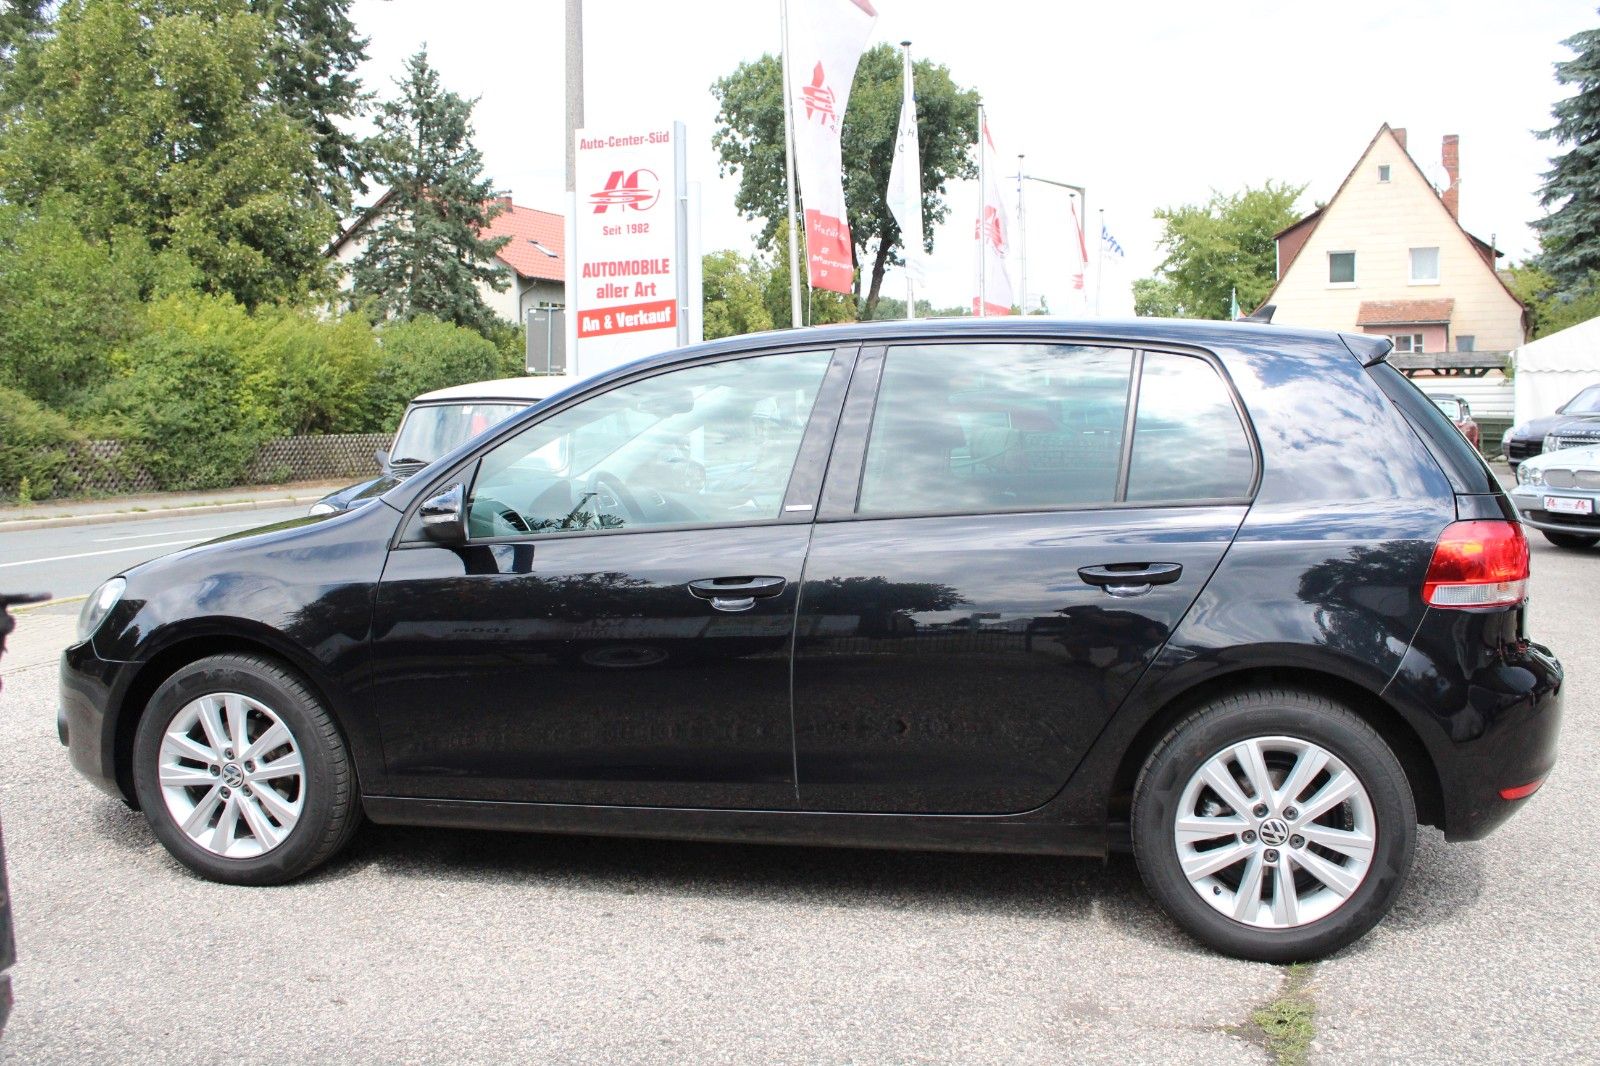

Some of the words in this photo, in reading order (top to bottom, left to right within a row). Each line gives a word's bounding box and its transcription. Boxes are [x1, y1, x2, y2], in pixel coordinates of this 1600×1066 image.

[580, 131, 669, 150] Auto-Center-Süd
[603, 226, 622, 236] Seit
[627, 222, 650, 234] 1982
[582, 258, 670, 278] AUTOMOBILE
[596, 283, 629, 299] aller
[635, 281, 657, 297] Art
[582, 316, 601, 333] An
[603, 314, 613, 330] &
[615, 306, 671, 328] Verkauf
